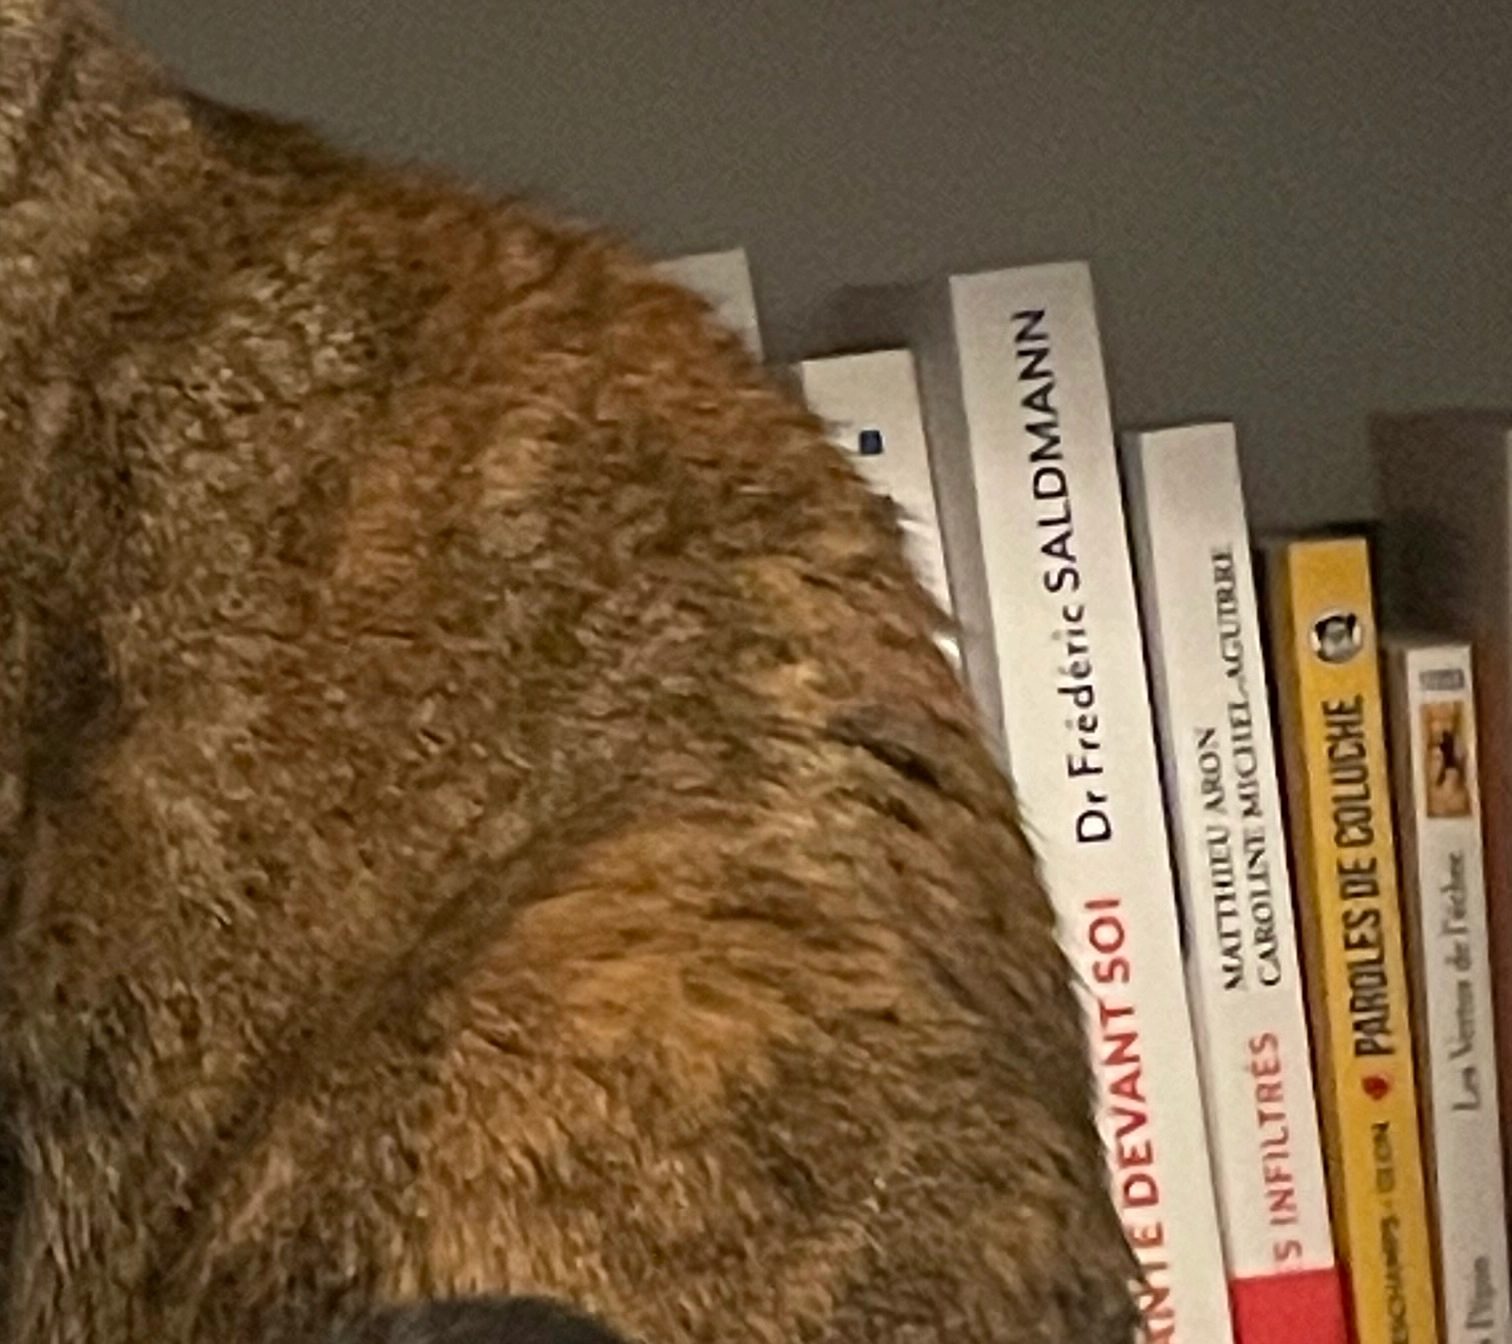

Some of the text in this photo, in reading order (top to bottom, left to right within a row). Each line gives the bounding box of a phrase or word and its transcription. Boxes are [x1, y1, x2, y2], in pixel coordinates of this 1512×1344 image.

[1010, 305, 1113, 845] Dr Frédéric SALDMANN
[1083, 898, 1131, 985] SOI
[1194, 726, 1249, 991] MATTHIEU ARON
[1242, 826, 1283, 988] CAROLINE
[1322, 693, 1396, 1057] PAROLES DE COLUCHE
[1097, 997, 1160, 1209] DEVANT
[1242, 1031, 1300, 1226] INFILTRÉS
